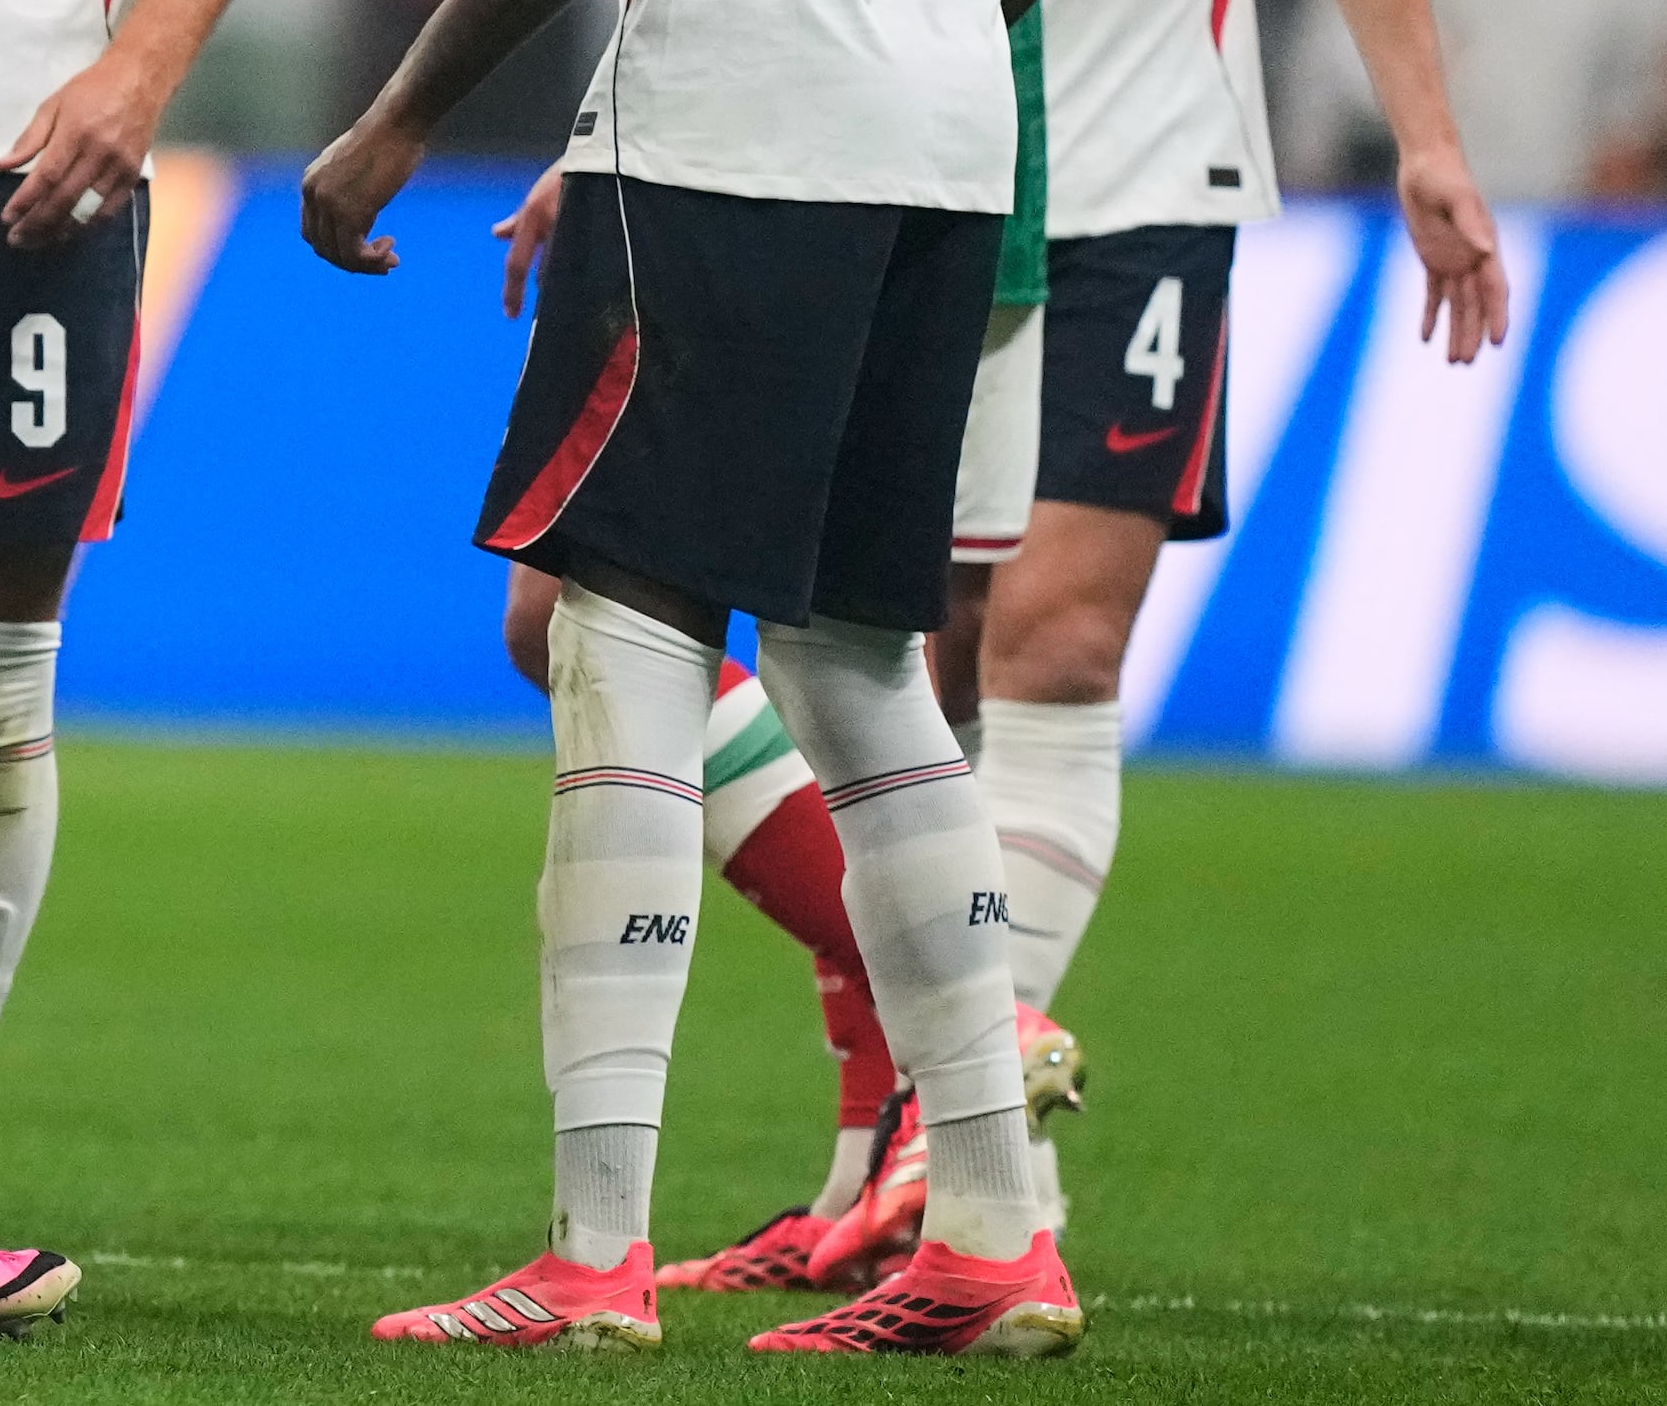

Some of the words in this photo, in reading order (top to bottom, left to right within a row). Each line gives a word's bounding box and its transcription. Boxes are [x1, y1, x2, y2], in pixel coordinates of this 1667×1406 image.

[9, 311, 68, 449] 9
[1124, 277, 1184, 410] 4
[619, 914, 690, 945] ENG
[969, 891, 1009, 926] ENG
